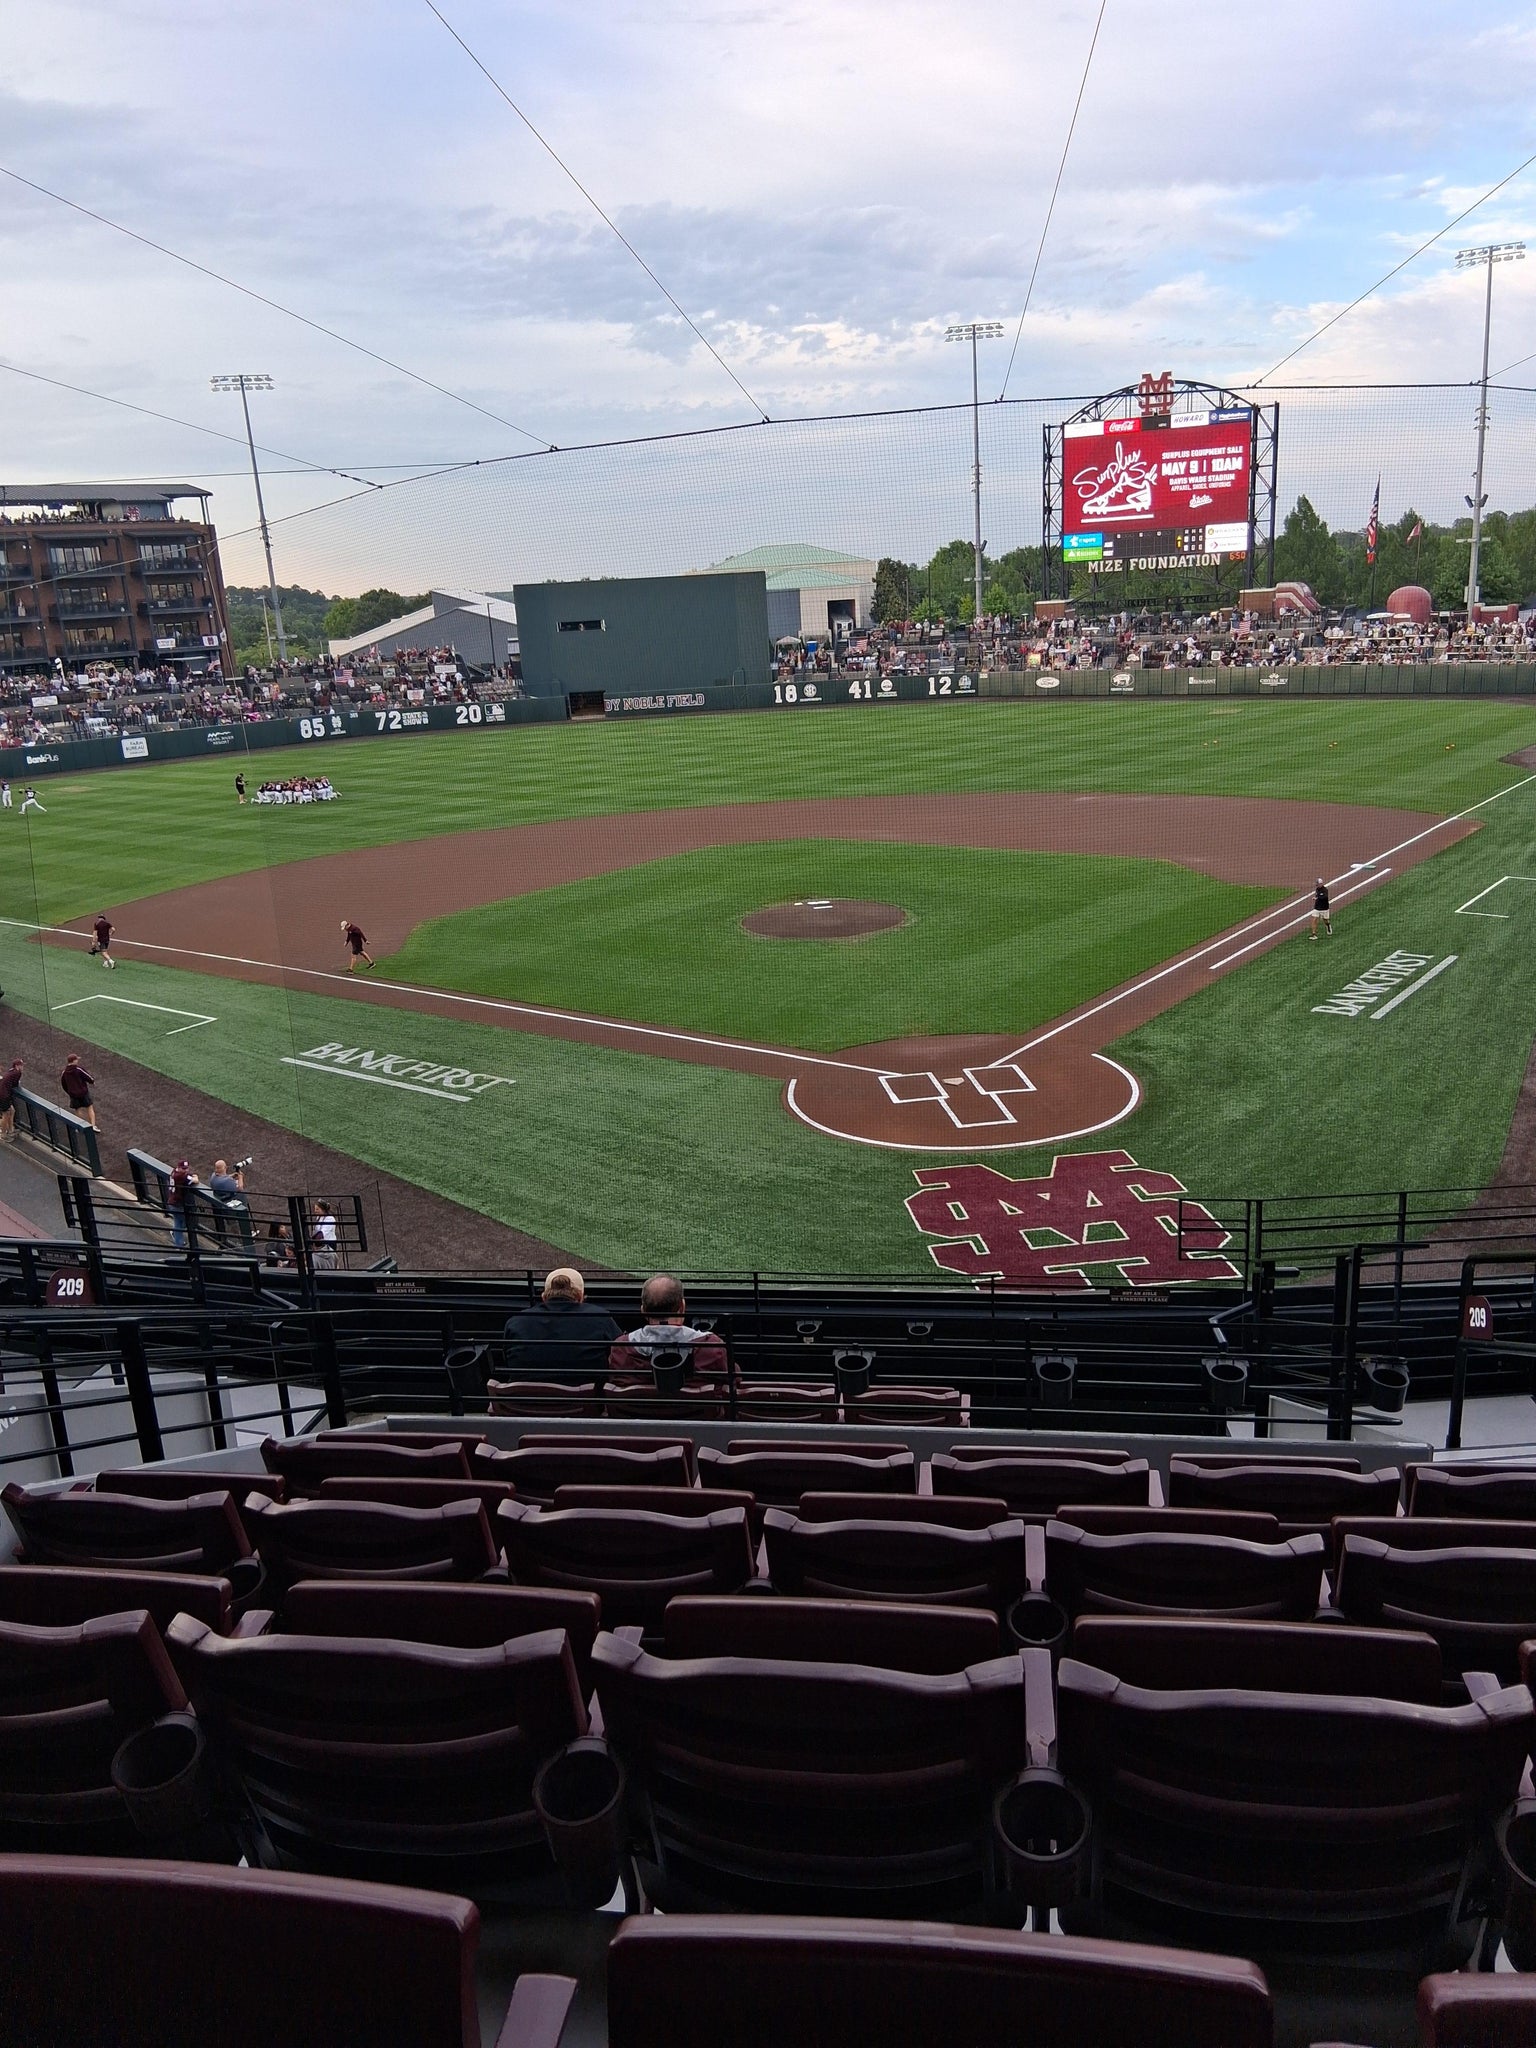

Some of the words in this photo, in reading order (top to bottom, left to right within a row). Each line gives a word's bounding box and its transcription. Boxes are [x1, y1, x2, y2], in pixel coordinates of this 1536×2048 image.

[1173, 414, 1204, 424] HOWARD
[1162, 450, 1190, 459] SURPLUS
[1191, 447, 1227, 457] EQUIPMENT
[1227, 446, 1243, 454] SALE
[1073, 441, 1141, 498] Surplus
[1161, 461, 1187, 476] MAY
[1189, 460, 1198, 473] 9
[1212, 457, 1243, 472] 10AM
[1208, 473, 1235, 482] STADIUM
[1088, 559, 1123, 573] MIZE
[1129, 553, 1221, 571] FOUNDATION
[774, 685, 798, 704] 18
[849, 680, 872, 699] 41
[928, 676, 952, 695] 12
[623, 696, 665, 711] NOBLE
[667, 693, 705, 708] FIELD
[375, 711, 402, 731] 72
[455, 705, 482, 724] 20
[300, 717, 326, 739] 85
[26, 754, 59, 765] BankPlus
[1310, 950, 1435, 1017] BANKFIRST
[299, 1042, 517, 1094] BANKFIRST
[57, 1279, 84, 1296] 209
[1469, 1307, 1486, 1328] 209
